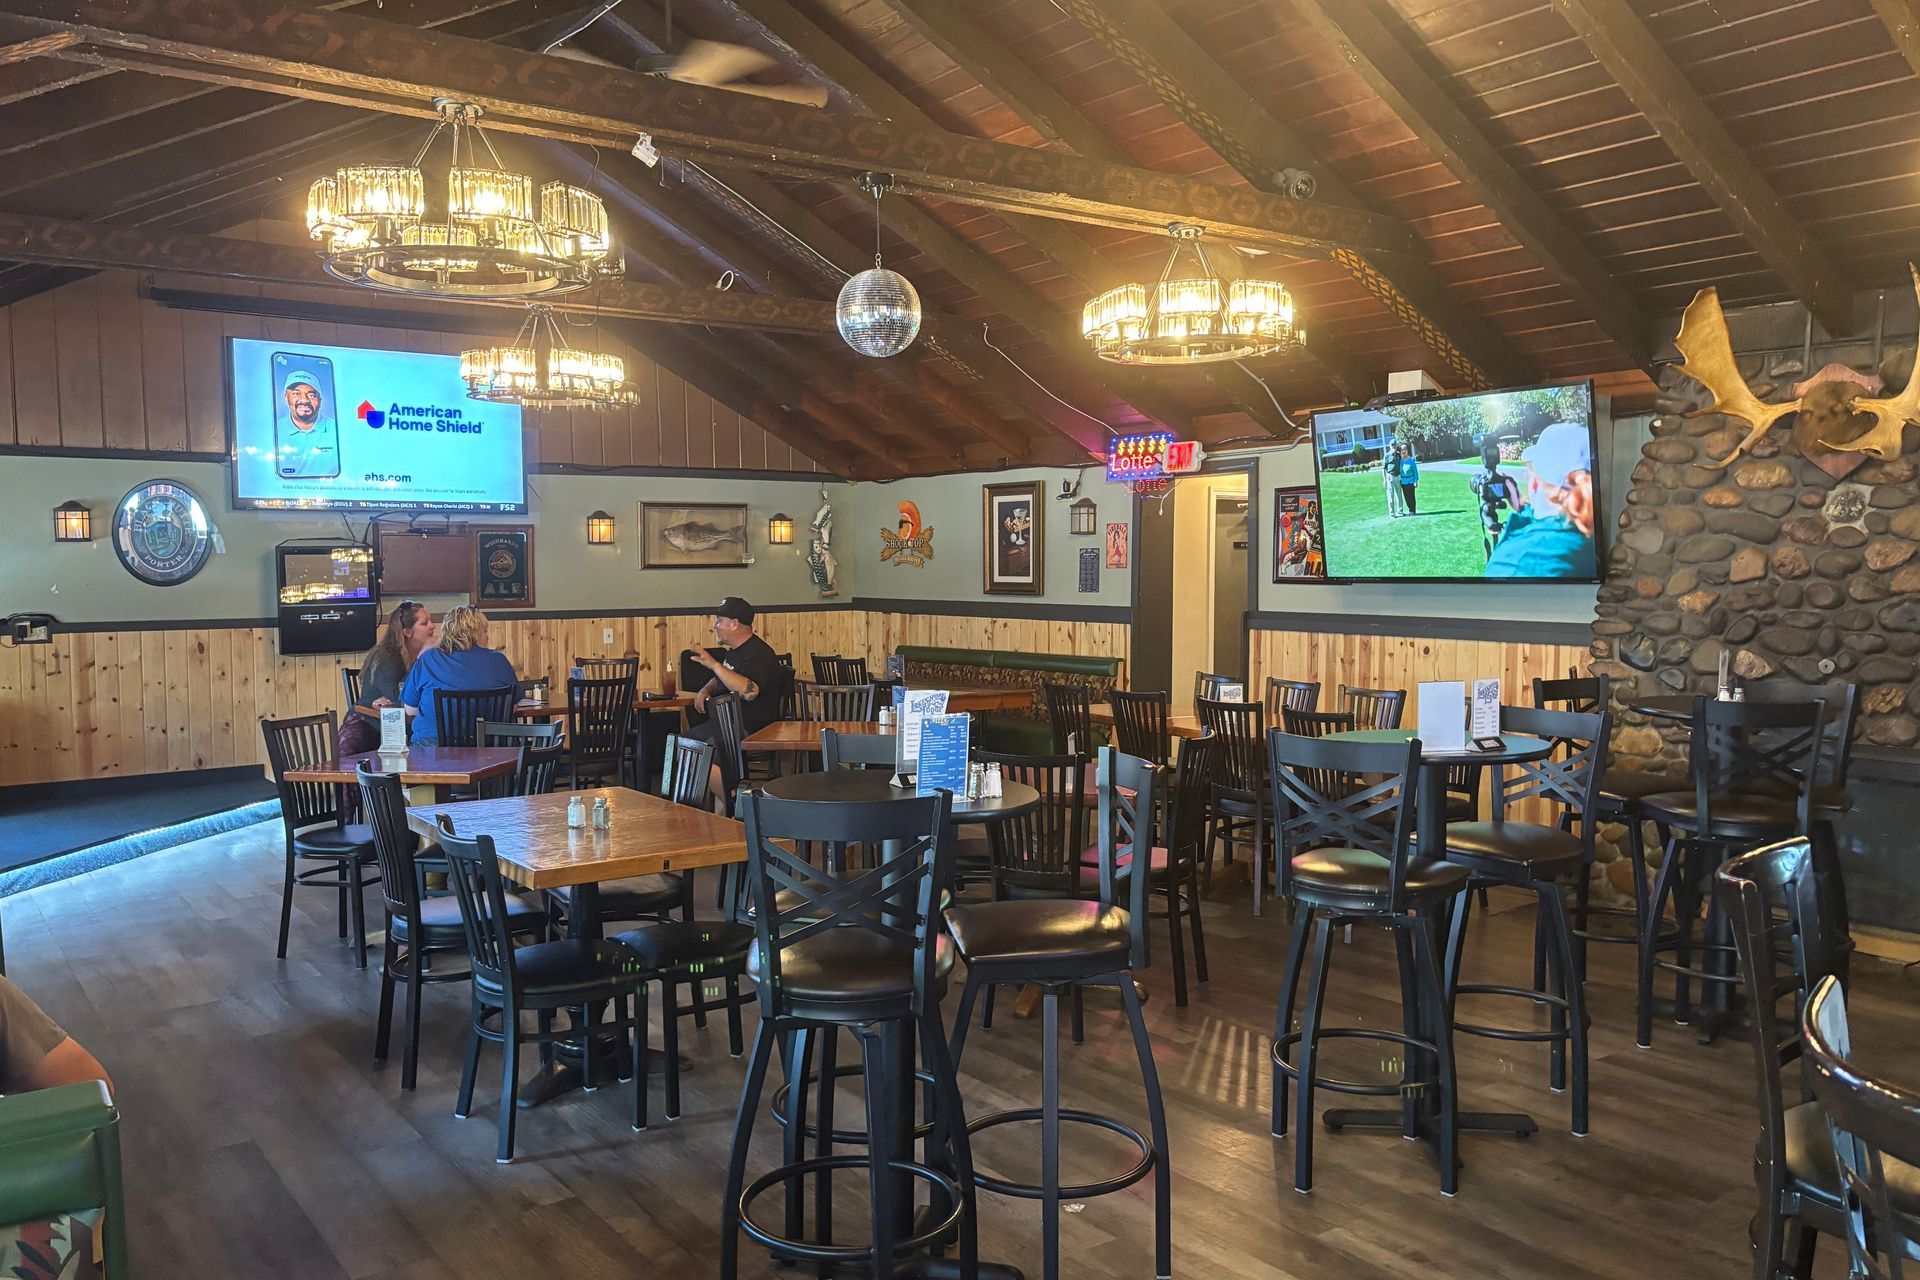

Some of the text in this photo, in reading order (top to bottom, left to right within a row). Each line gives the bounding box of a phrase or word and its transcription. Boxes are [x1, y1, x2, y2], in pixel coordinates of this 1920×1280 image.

[389, 403, 462, 419] American
[389, 417, 482, 434] Home Shield
[1167, 443, 1194, 470] EXIT
[364, 471, 412, 483] ahs.com
[885, 537, 924, 549] SHOCK TOP
[145, 554, 183, 568] PORTER
[484, 582, 521, 595] ALE
